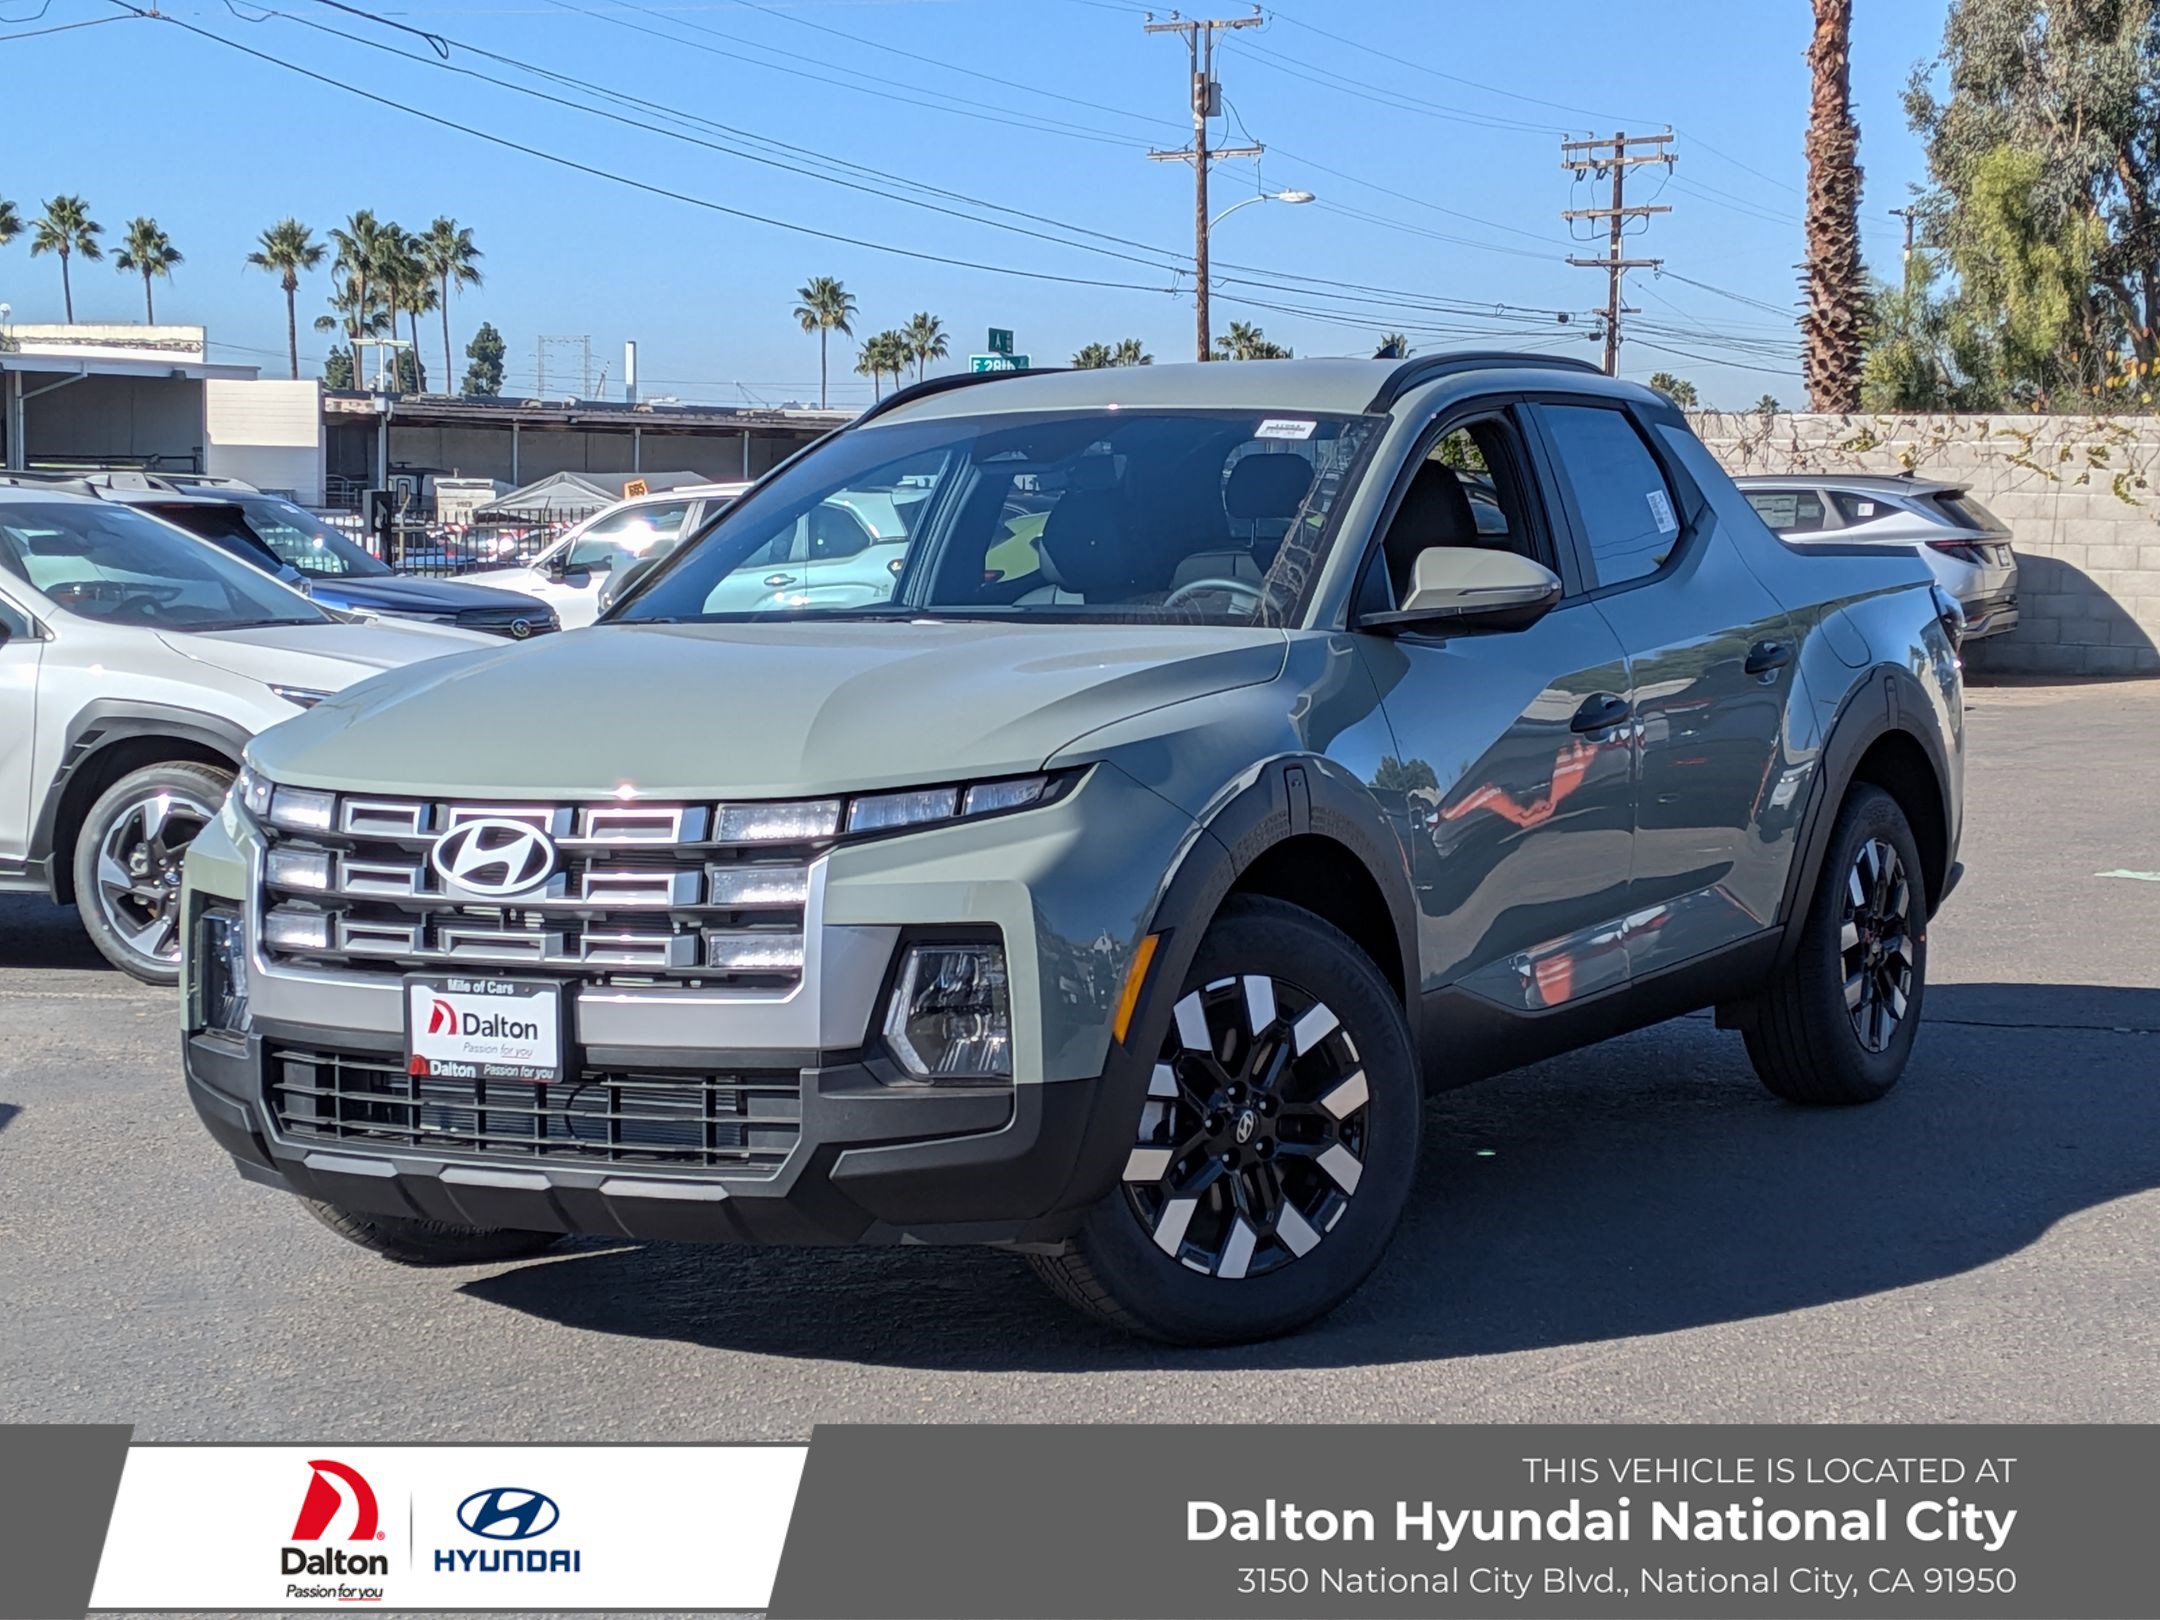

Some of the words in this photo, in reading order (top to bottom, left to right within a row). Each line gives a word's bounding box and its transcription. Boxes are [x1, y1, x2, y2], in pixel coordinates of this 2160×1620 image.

[447, 979, 471, 993] Mile
[473, 980, 486, 993] of
[487, 981, 514, 994] Cars
[462, 1013, 538, 1040] Dalton
[463, 1042, 498, 1055] Passion
[497, 1043, 514, 1056] for
[515, 1047, 534, 1058] you
[430, 1060, 476, 1078] Dalton
[484, 1064, 520, 1077] Passion
[520, 1065, 535, 1079] for
[535, 1068, 554, 1081] you
